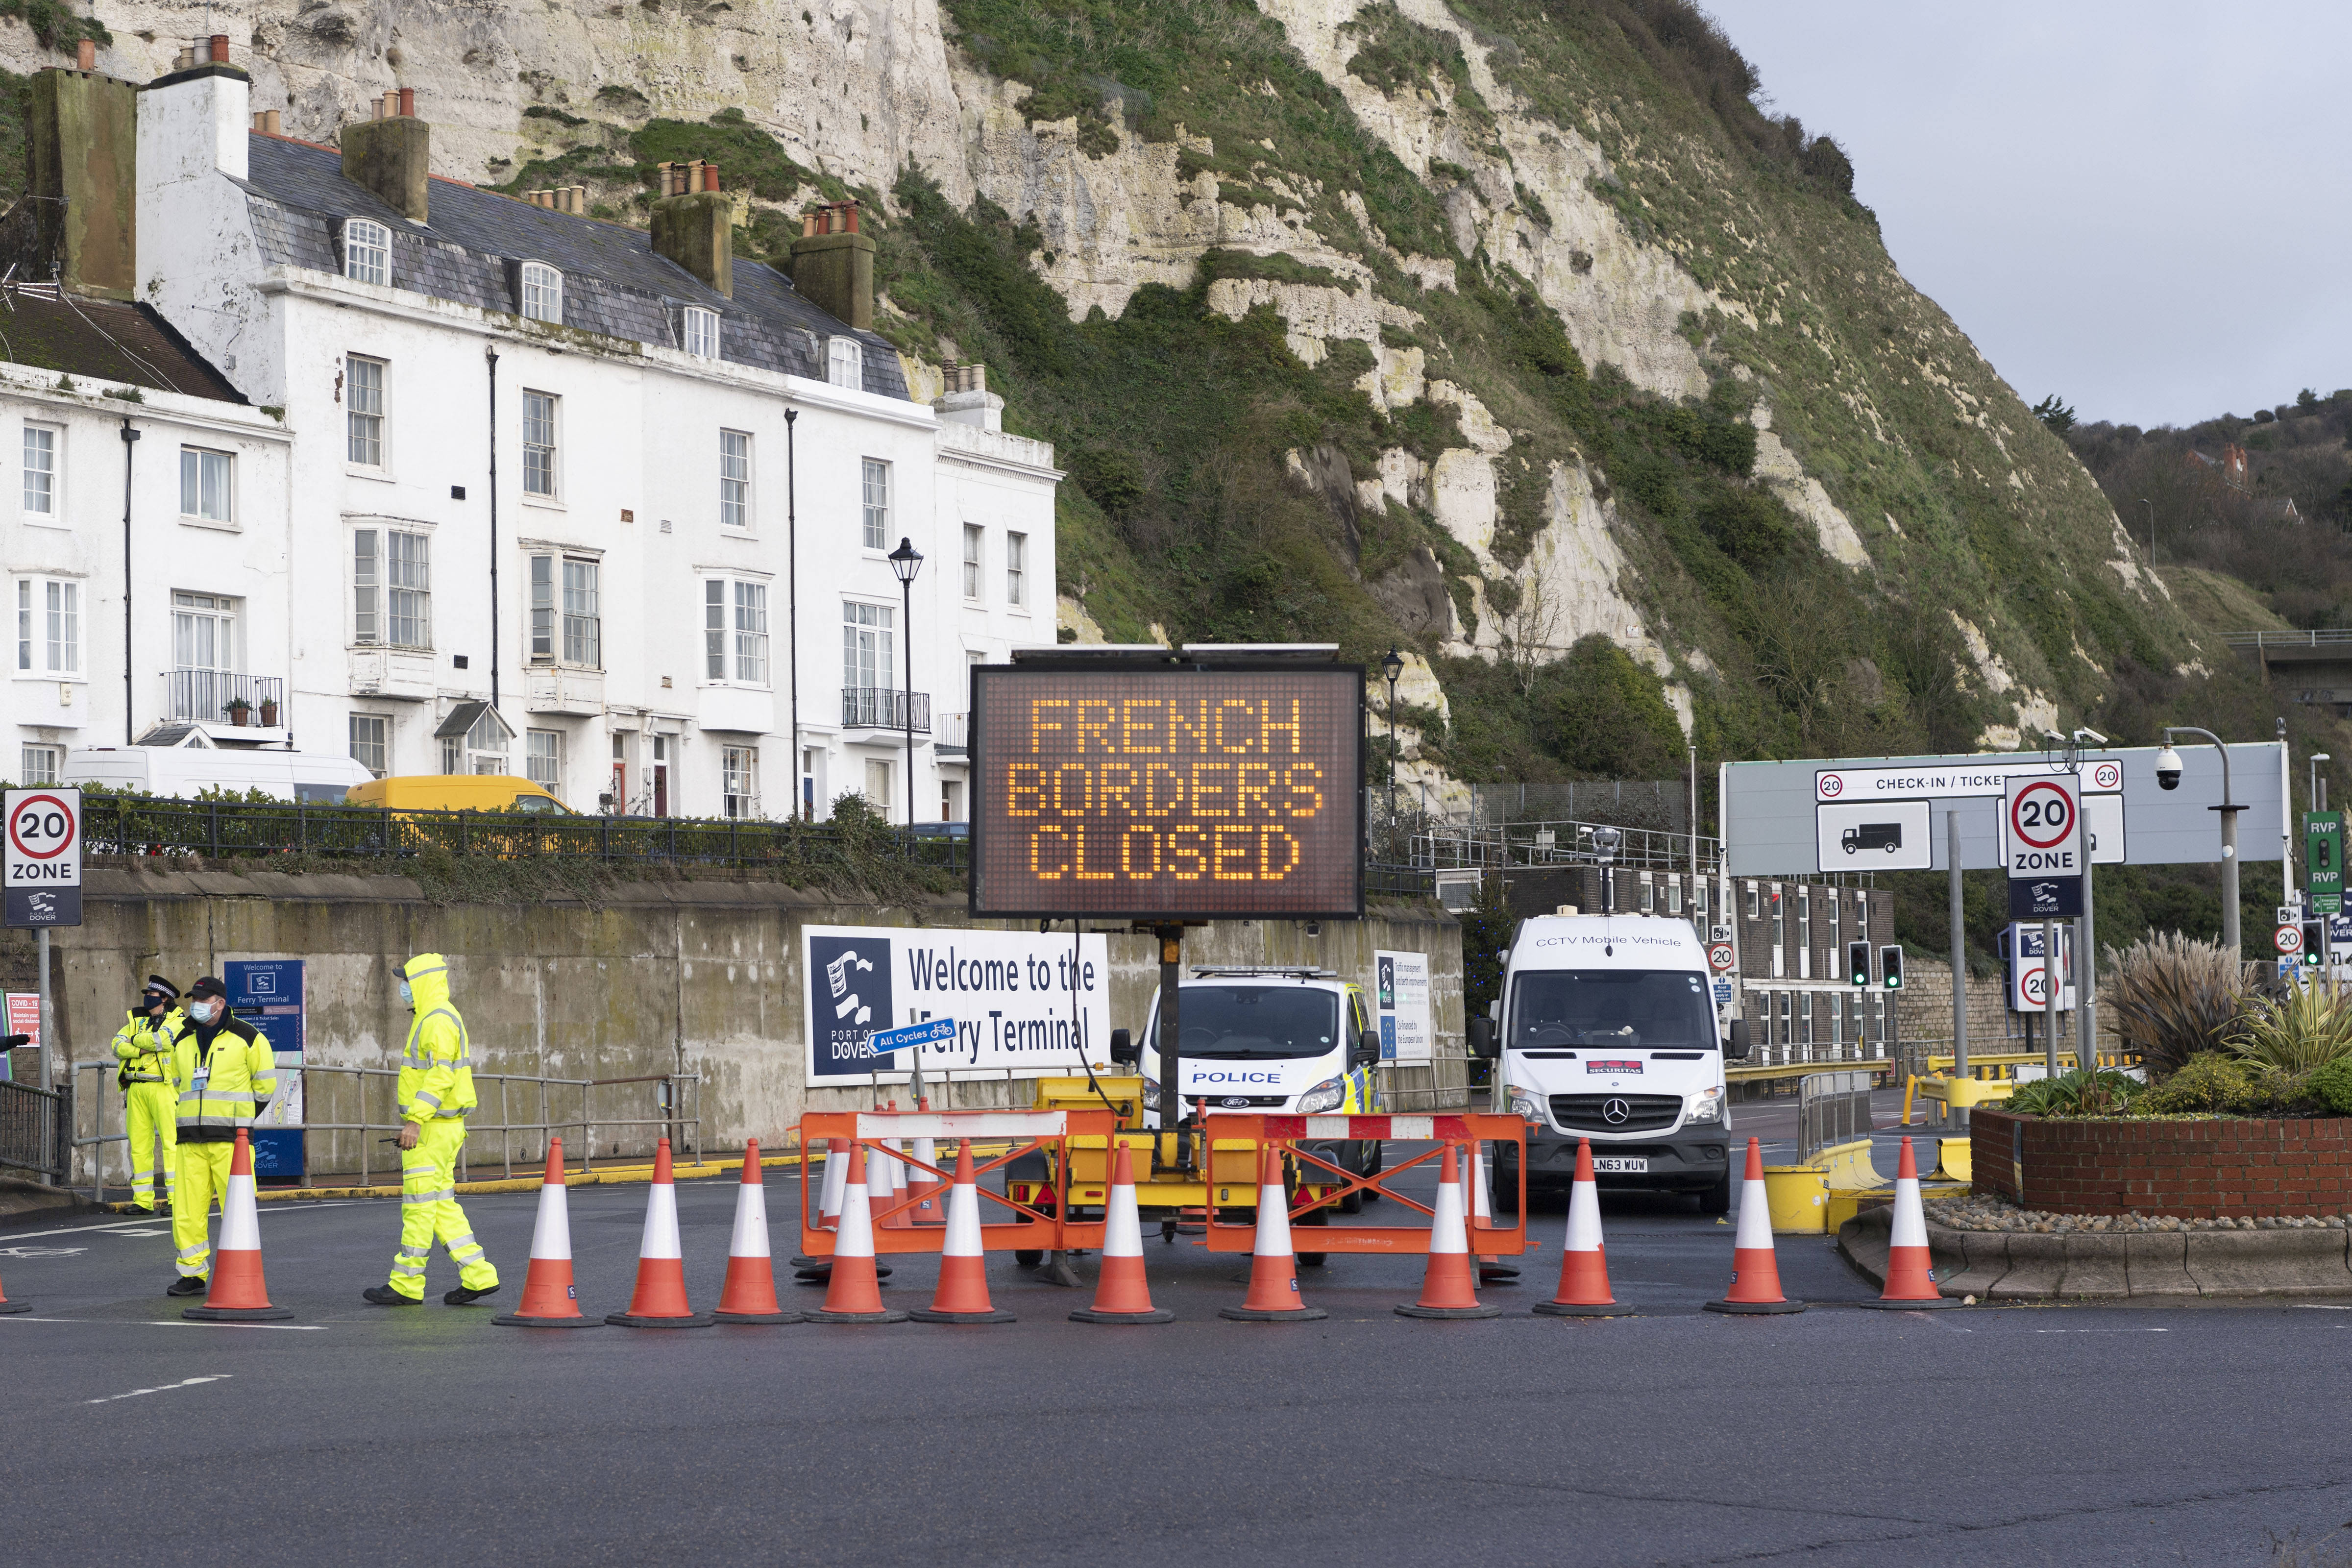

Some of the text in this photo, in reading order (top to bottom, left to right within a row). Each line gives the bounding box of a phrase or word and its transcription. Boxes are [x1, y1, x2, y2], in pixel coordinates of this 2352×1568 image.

[1031, 699, 1300, 754] FRENCH
[1877, 778, 1945, 789] CHECK-IN
[1960, 775, 2007, 787] TICKE
[2100, 772, 2115, 781] 20
[1008, 762, 1323, 817] BORDERS
[1824, 781, 1840, 790] 20
[2022, 800, 2065, 827] 20
[21, 812, 65, 838] 20
[2311, 822, 2336, 833] RVP
[1030, 825, 1300, 880] CLOSED
[2016, 852, 2073, 870] ZONE
[13, 863, 72, 879] ZONE
[2313, 872, 2338, 882] RVP
[1536, 936, 1681, 947] CCTV Mobile Vehicle
[2279, 933, 2298, 945] 20
[1714, 951, 1731, 963] 20
[908, 946, 1094, 991] Welcome to the
[1396, 962, 1421, 975] Traffic management
[832, 1030, 858, 1040] PORT
[989, 1007, 1089, 1052] Terminal
[881, 1030, 928, 1046] All Cycles
[1403, 1034, 1415, 1045] European
[832, 1042, 876, 1059] DOVE
[1193, 1073, 1281, 1083] POLICE
[1593, 1160, 1644, 1170] LN63 WUW
